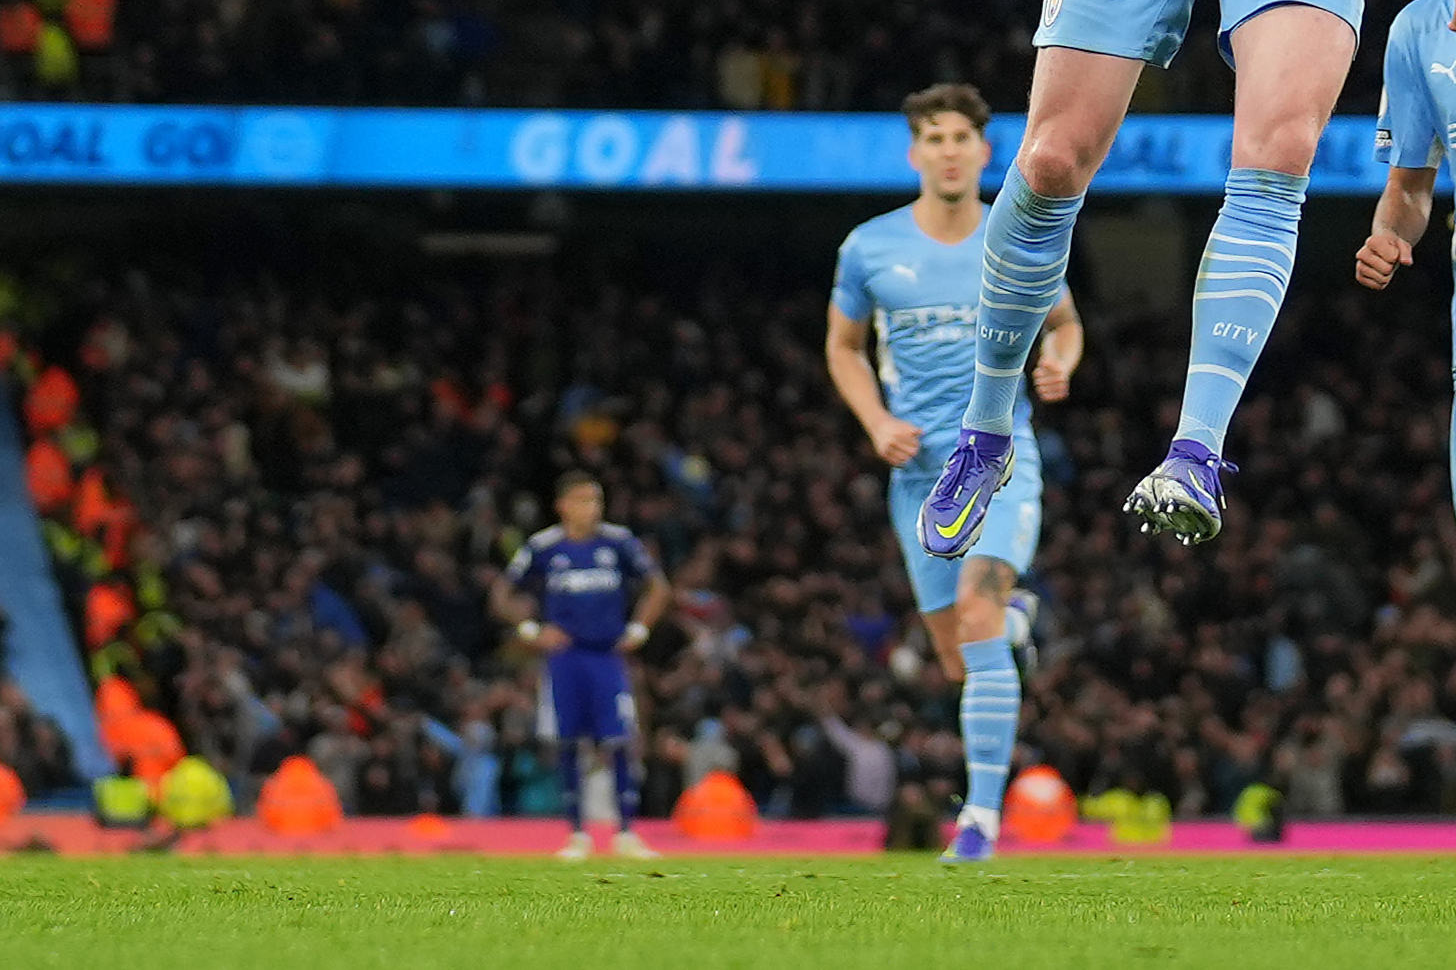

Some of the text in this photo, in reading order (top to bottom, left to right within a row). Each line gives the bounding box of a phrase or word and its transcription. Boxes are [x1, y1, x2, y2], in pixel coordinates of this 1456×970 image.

[513, 112, 758, 185] GOAL
[980, 324, 1022, 346] CITY
[1212, 321, 1259, 346] CITY
